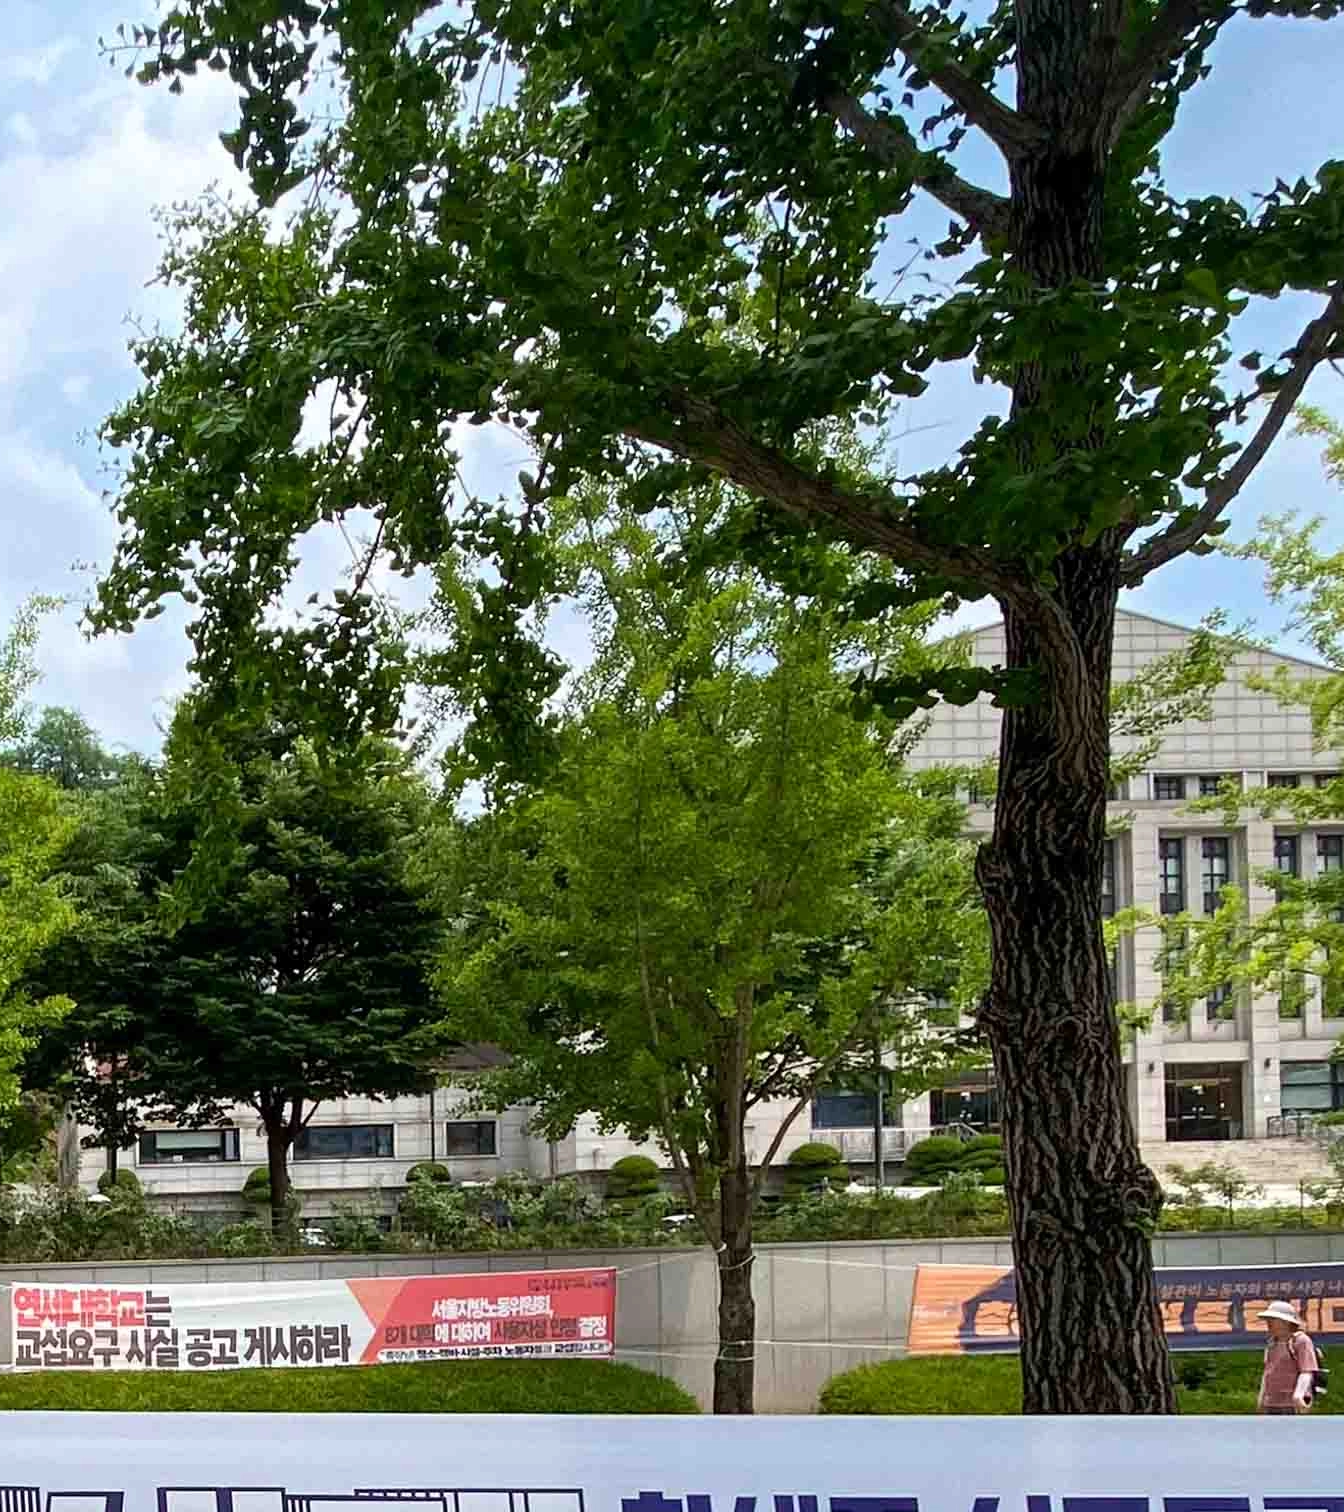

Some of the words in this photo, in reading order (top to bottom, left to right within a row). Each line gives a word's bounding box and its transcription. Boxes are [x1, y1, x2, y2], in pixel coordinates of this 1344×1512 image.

[14, 1288, 172, 1328] 연세대학교는
[432, 1294, 554, 1319] 서울지방노동위원회,
[16, 1328, 120, 1367] 교섭요구
[125, 1327, 178, 1368] 사실
[185, 1327, 239, 1367] 공고
[243, 1324, 351, 1366] 게시하라
[451, 1320, 491, 1343] 대하여
[578, 1315, 607, 1337] 결정
